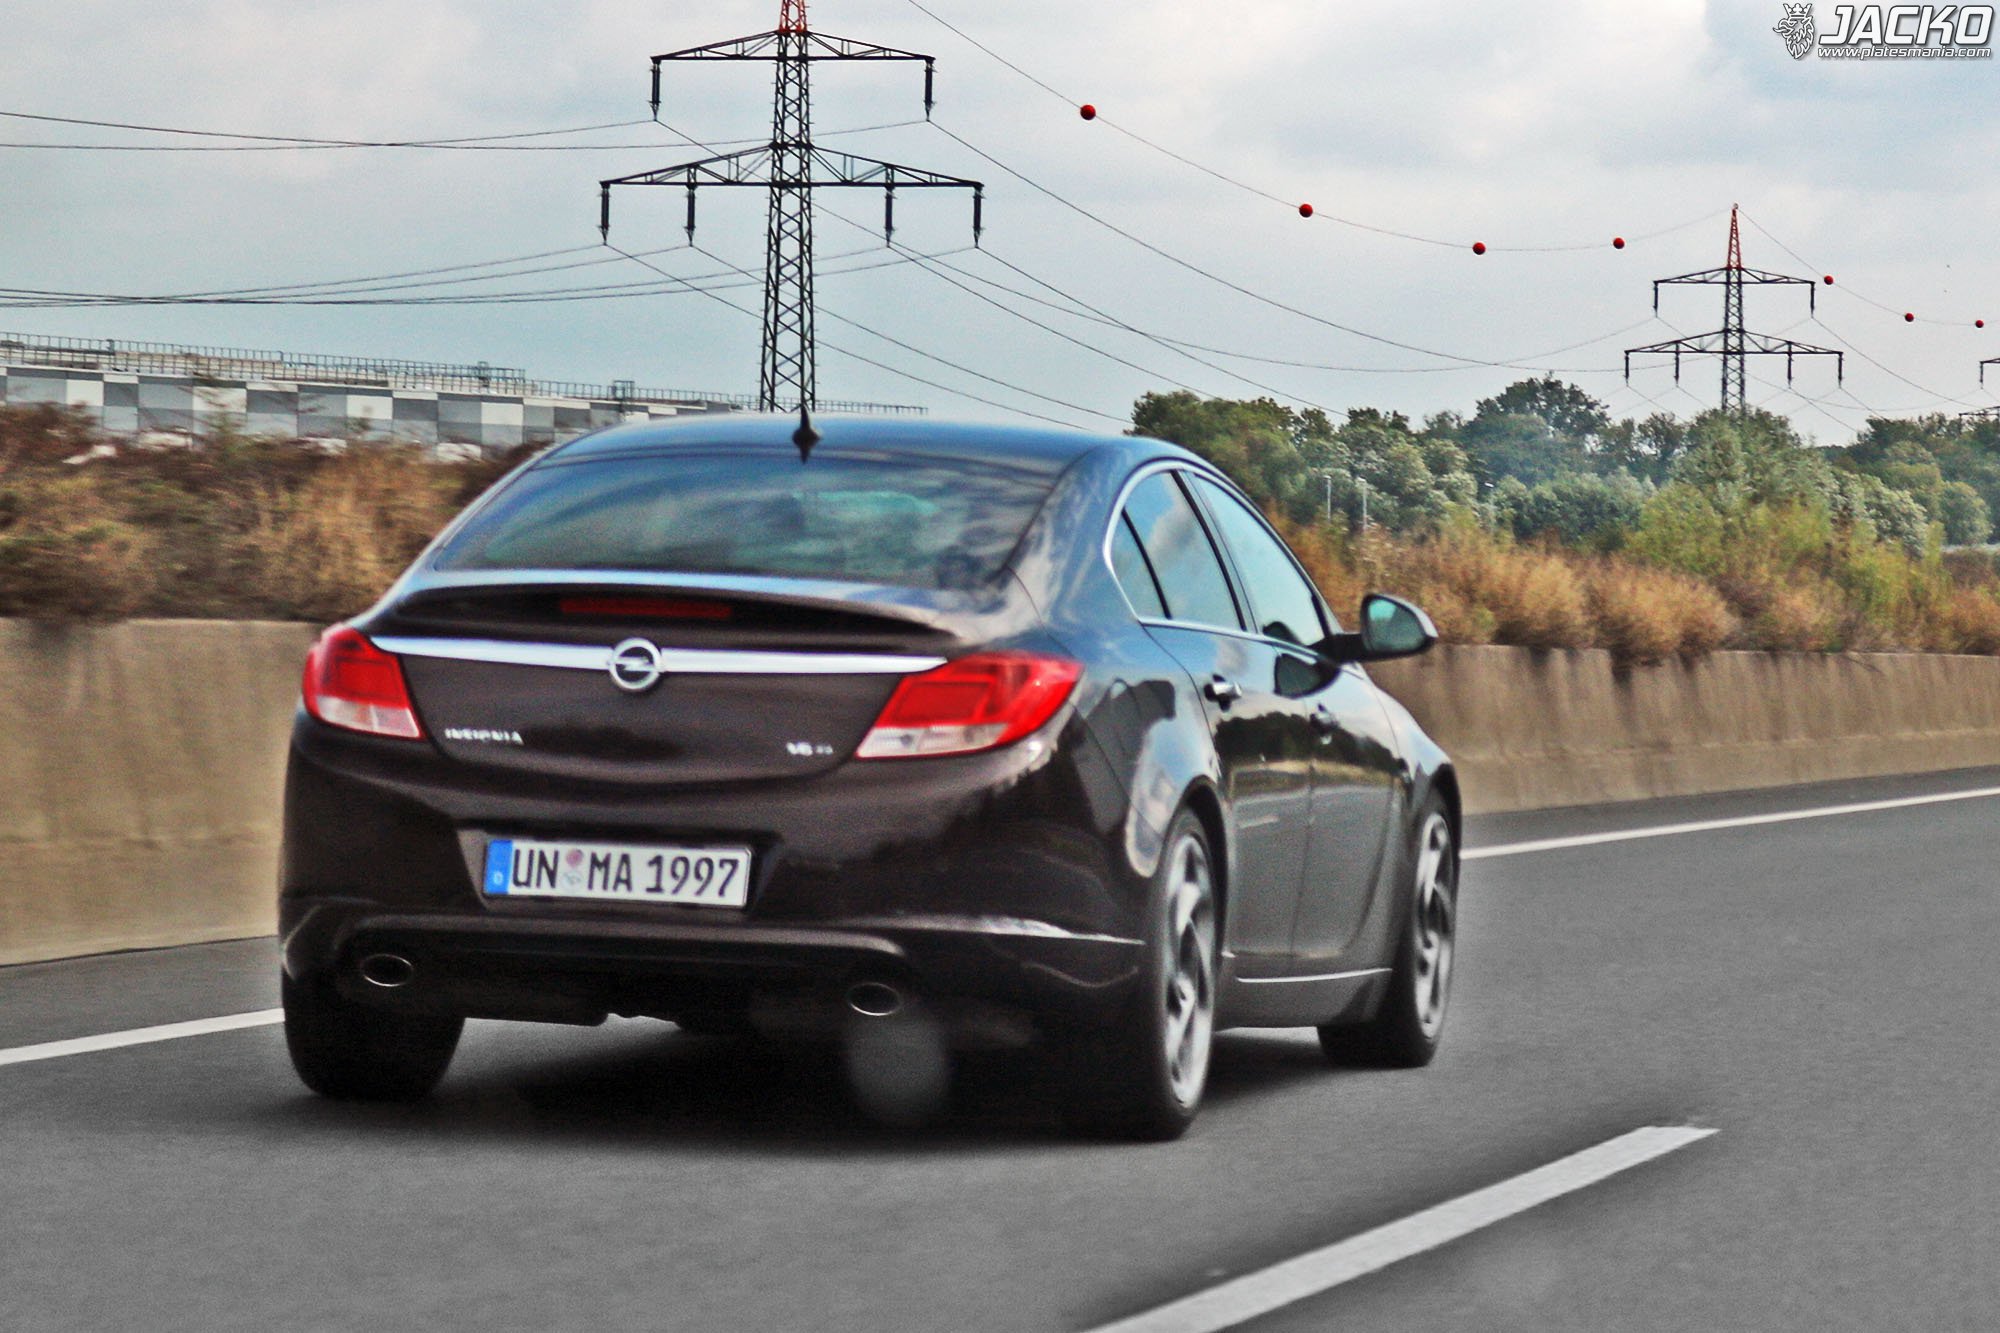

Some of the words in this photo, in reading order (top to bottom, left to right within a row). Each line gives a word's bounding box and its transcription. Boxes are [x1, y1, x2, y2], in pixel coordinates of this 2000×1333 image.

[513, 848, 559, 888] UN
[587, 851, 632, 892] MA
[645, 854, 739, 897] 1997
